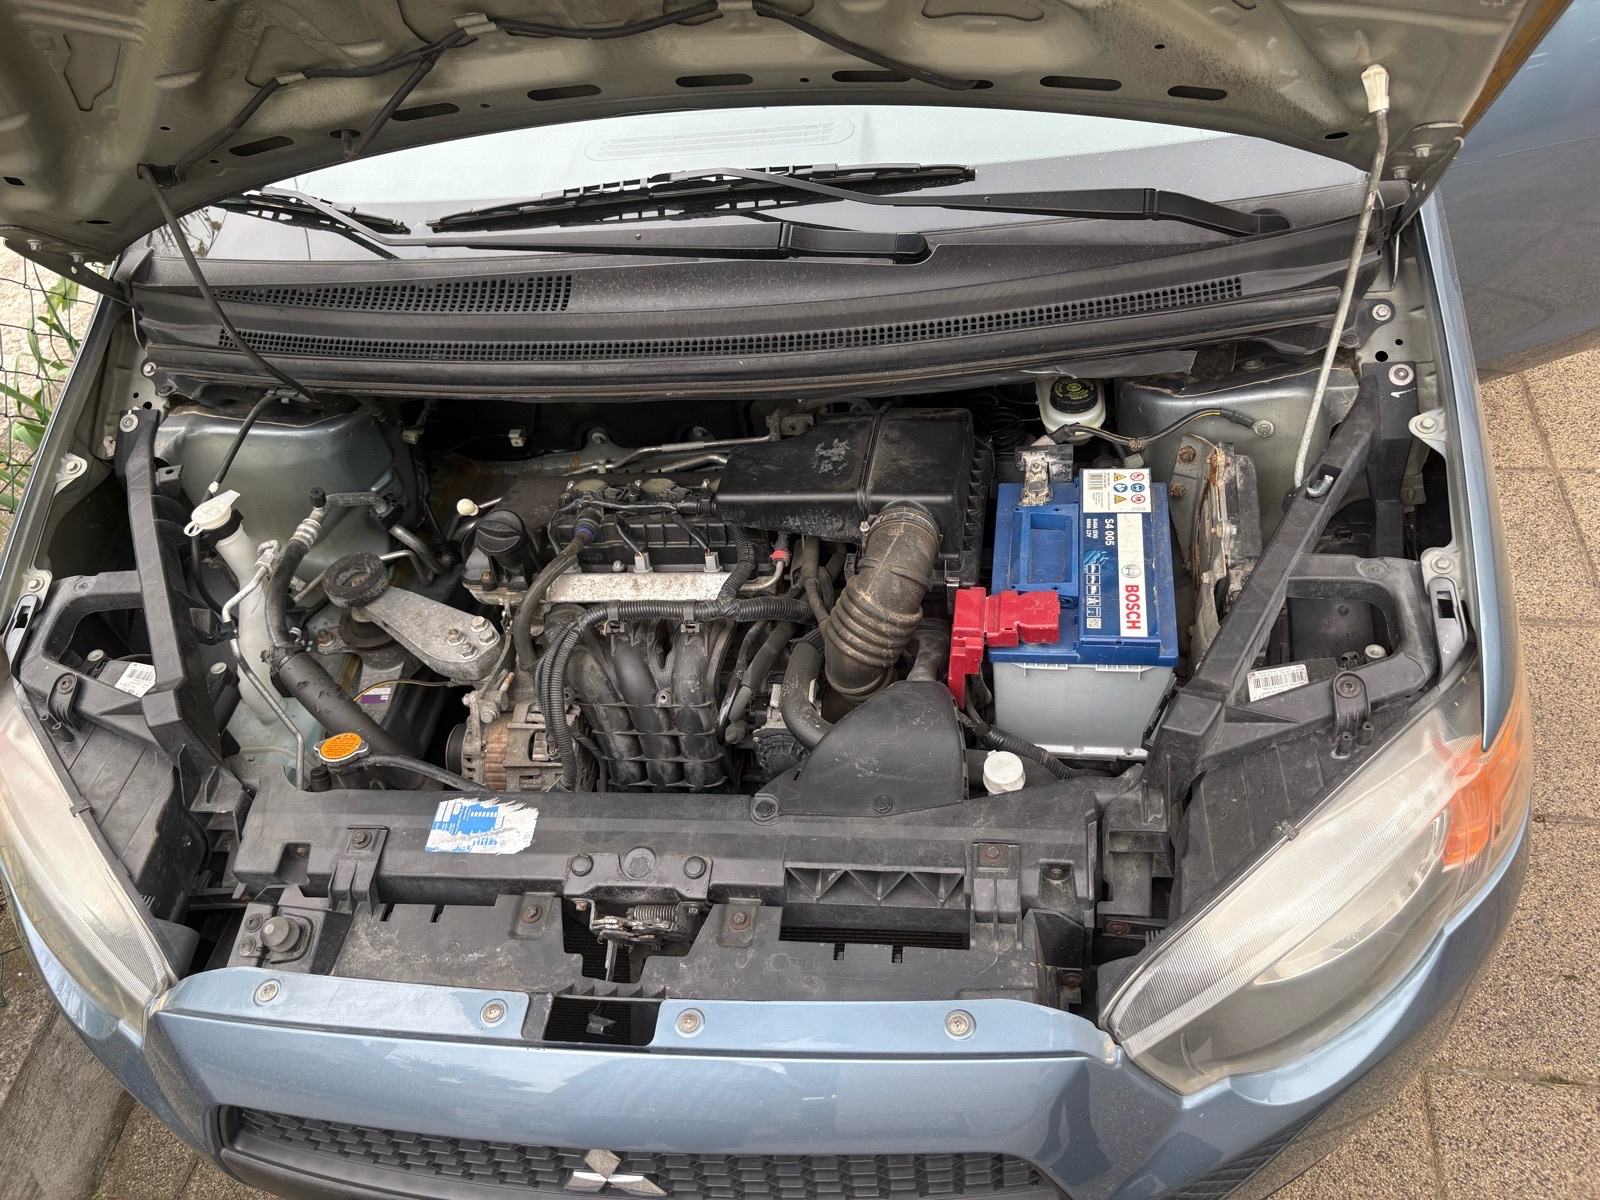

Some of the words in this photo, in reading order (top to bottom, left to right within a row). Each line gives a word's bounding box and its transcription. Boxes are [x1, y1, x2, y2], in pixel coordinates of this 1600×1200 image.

[1104, 518, 1115, 529] S4
[1104, 530, 1115, 546] 005
[1124, 584, 1142, 630] BOSCH
